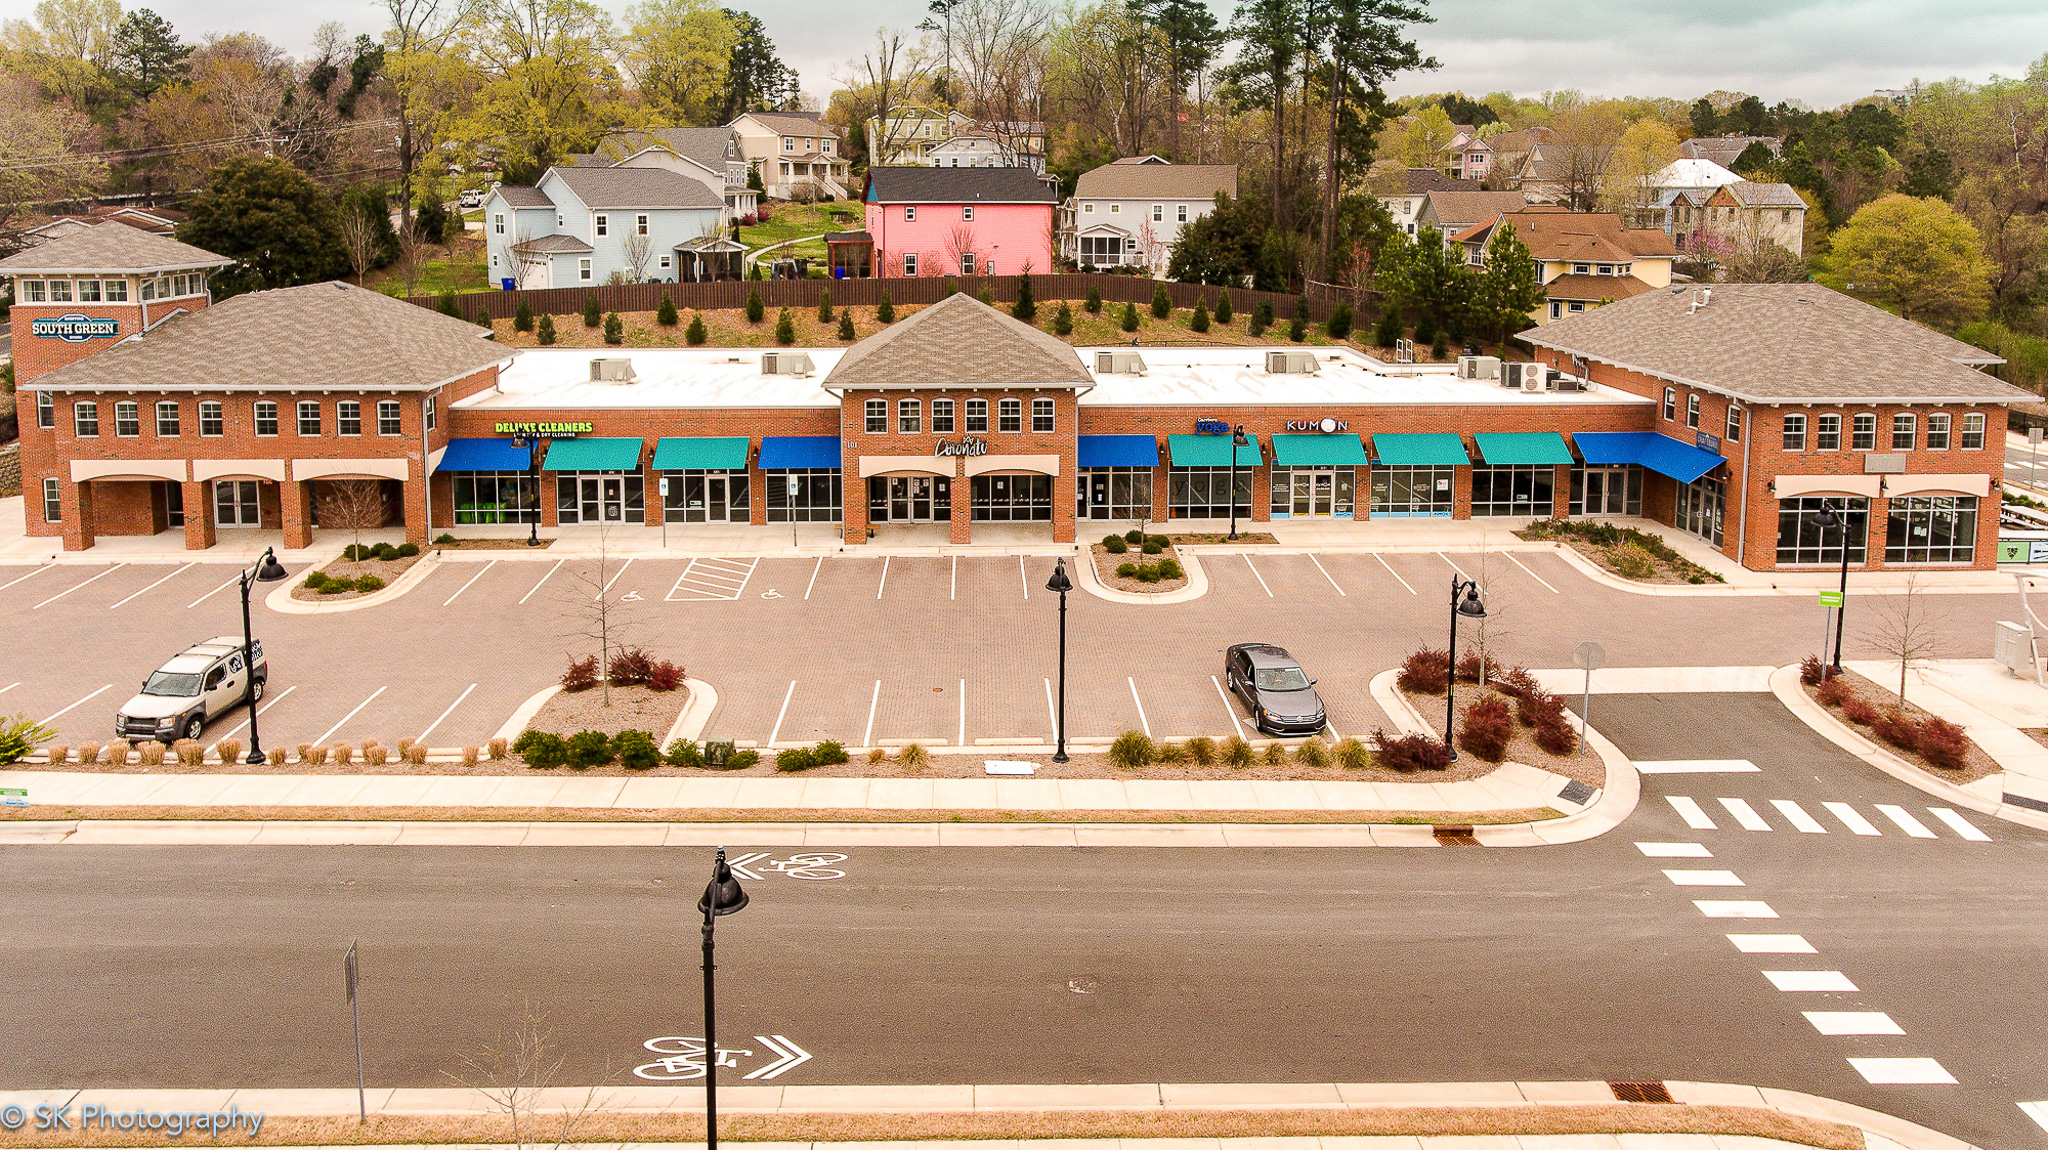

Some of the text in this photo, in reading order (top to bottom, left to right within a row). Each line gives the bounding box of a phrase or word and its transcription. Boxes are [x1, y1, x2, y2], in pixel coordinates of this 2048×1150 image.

[32, 323, 114, 334] SOUTH GREEN
[495, 422, 593, 433] DELUXE CLEANERS
[1195, 421, 1230, 434] yoga
[1286, 418, 1348, 433] KUMON
